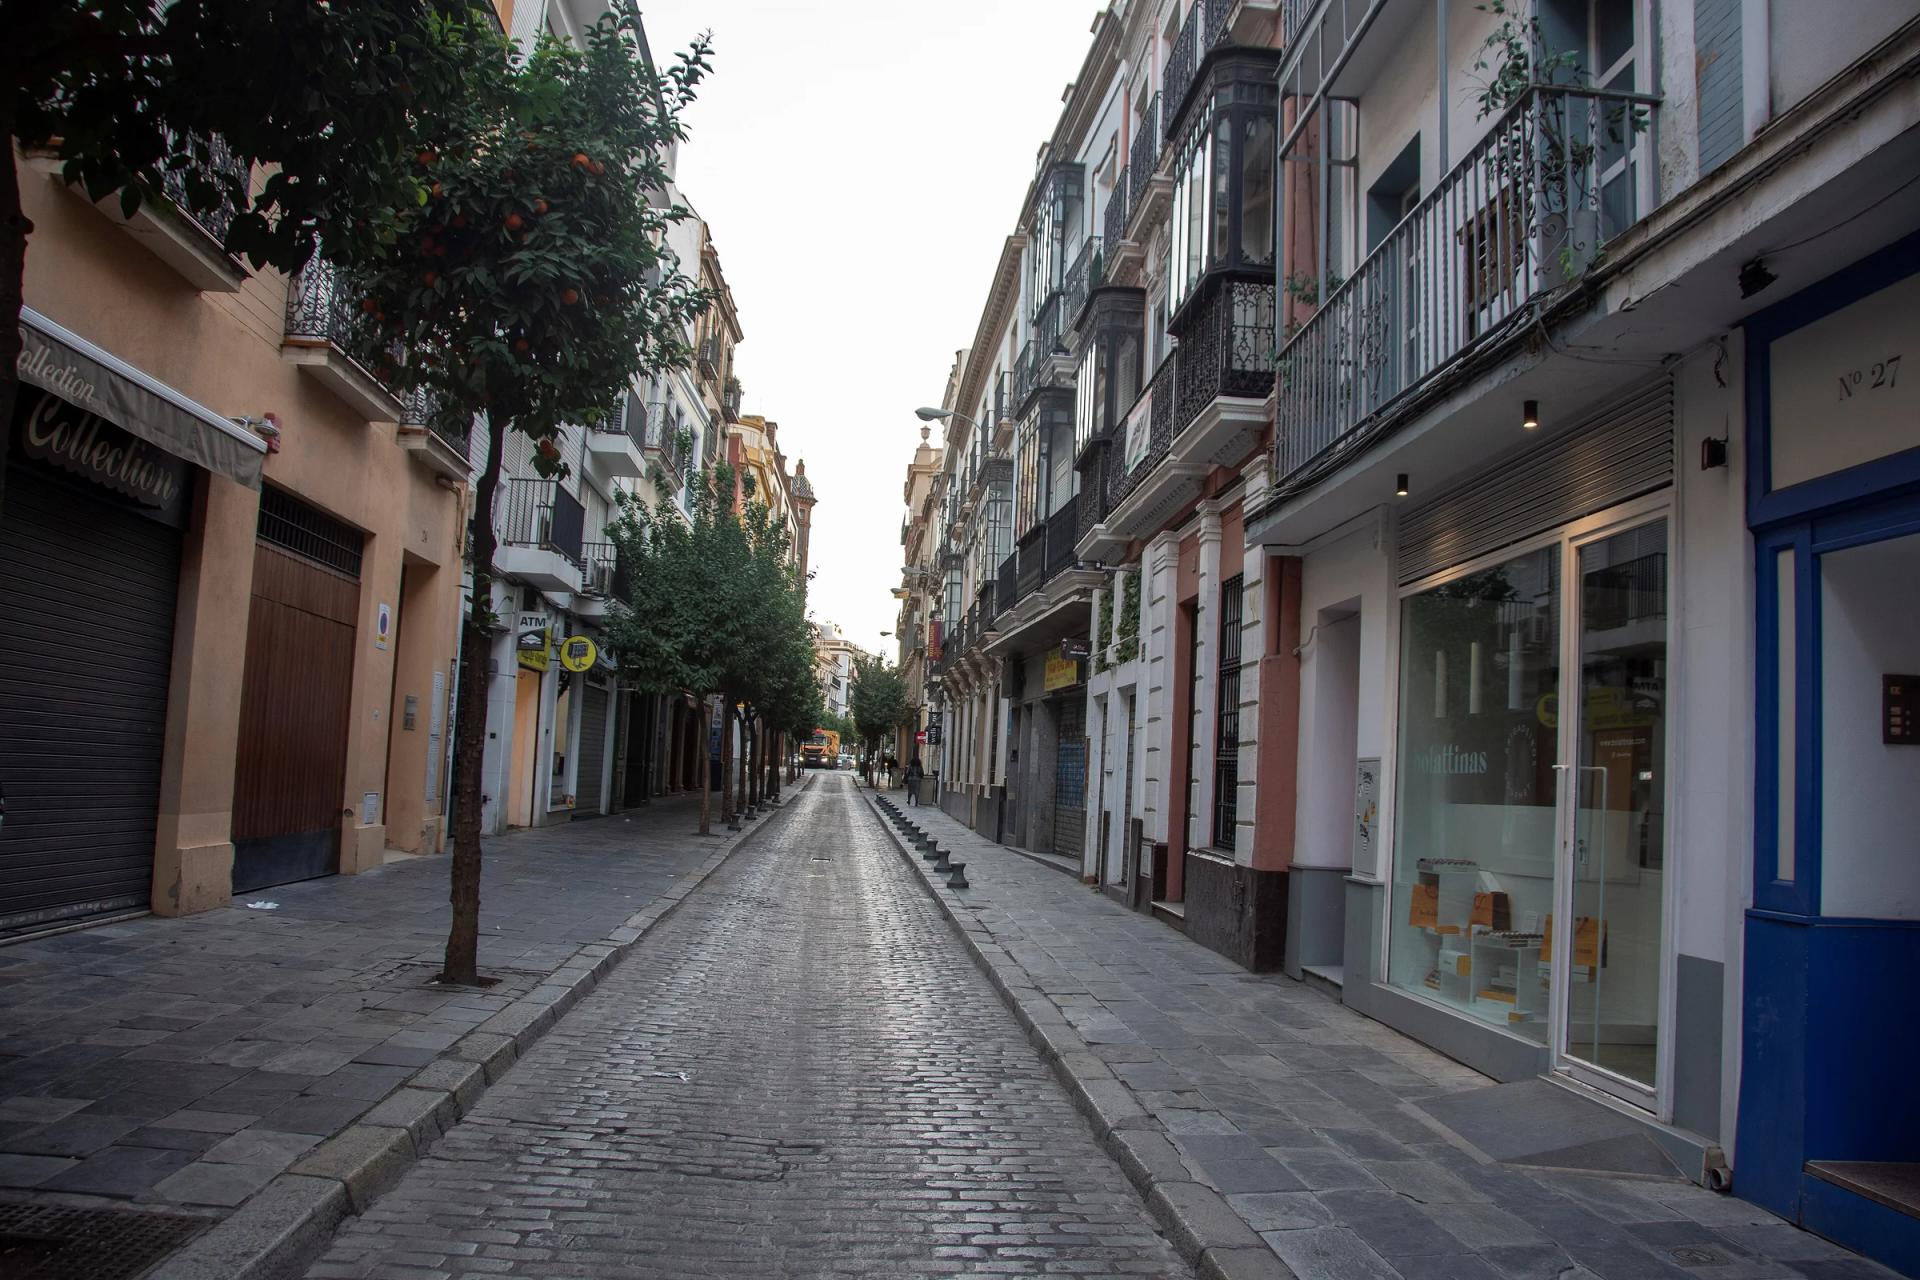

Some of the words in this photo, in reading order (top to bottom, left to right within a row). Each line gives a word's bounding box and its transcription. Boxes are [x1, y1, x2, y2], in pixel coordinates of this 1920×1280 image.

[1871, 354, 1903, 389] 27
[29, 393, 176, 501] Collection
[519, 616, 546, 627] ATM
